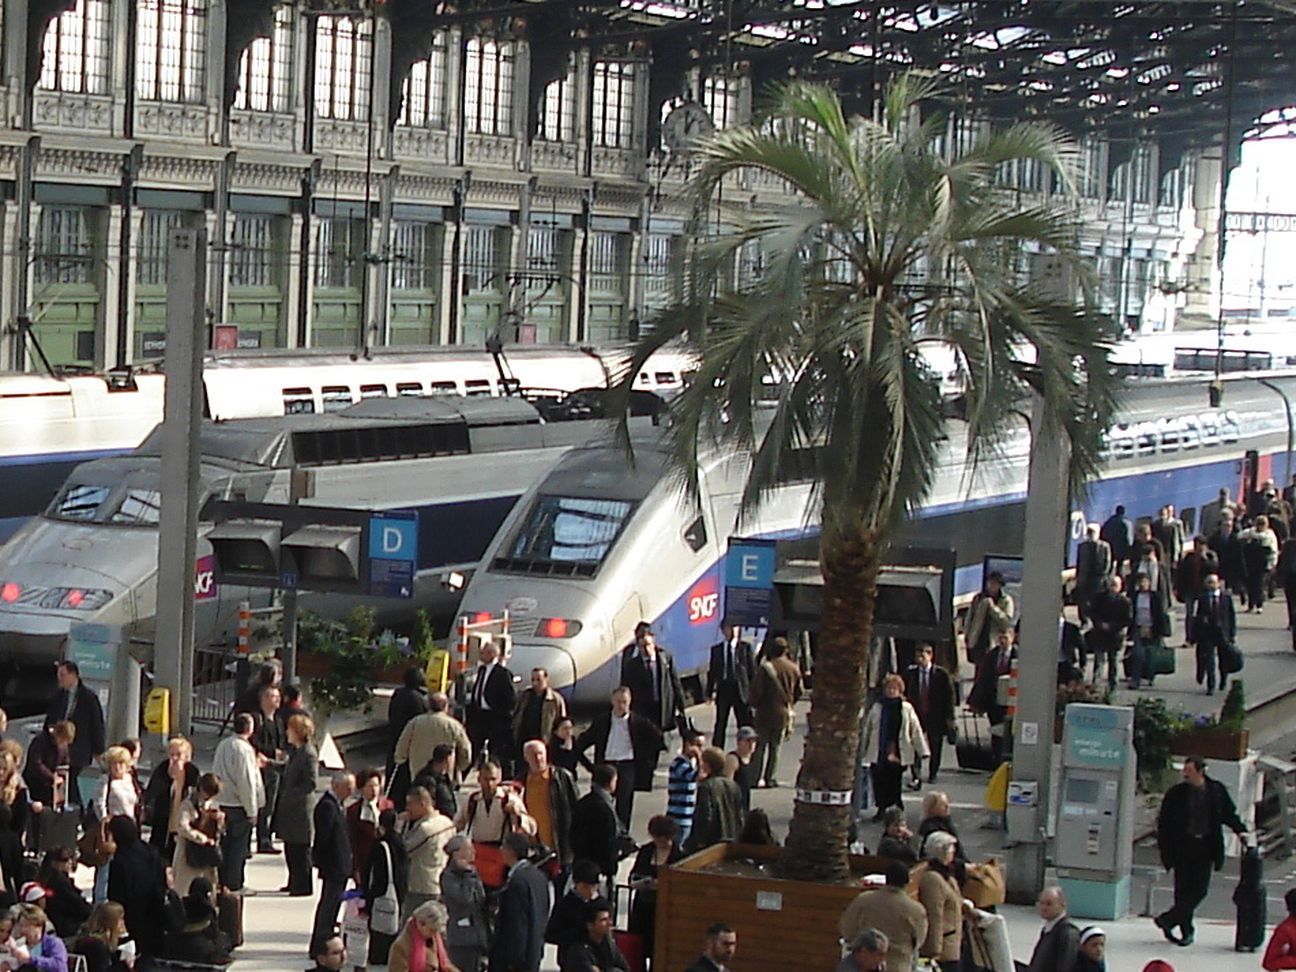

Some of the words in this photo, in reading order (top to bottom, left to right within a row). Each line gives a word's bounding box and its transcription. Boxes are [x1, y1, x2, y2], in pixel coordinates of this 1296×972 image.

[383, 527, 402, 552] D
[742, 555, 759, 580] E
[690, 593, 718, 620] SNCF
